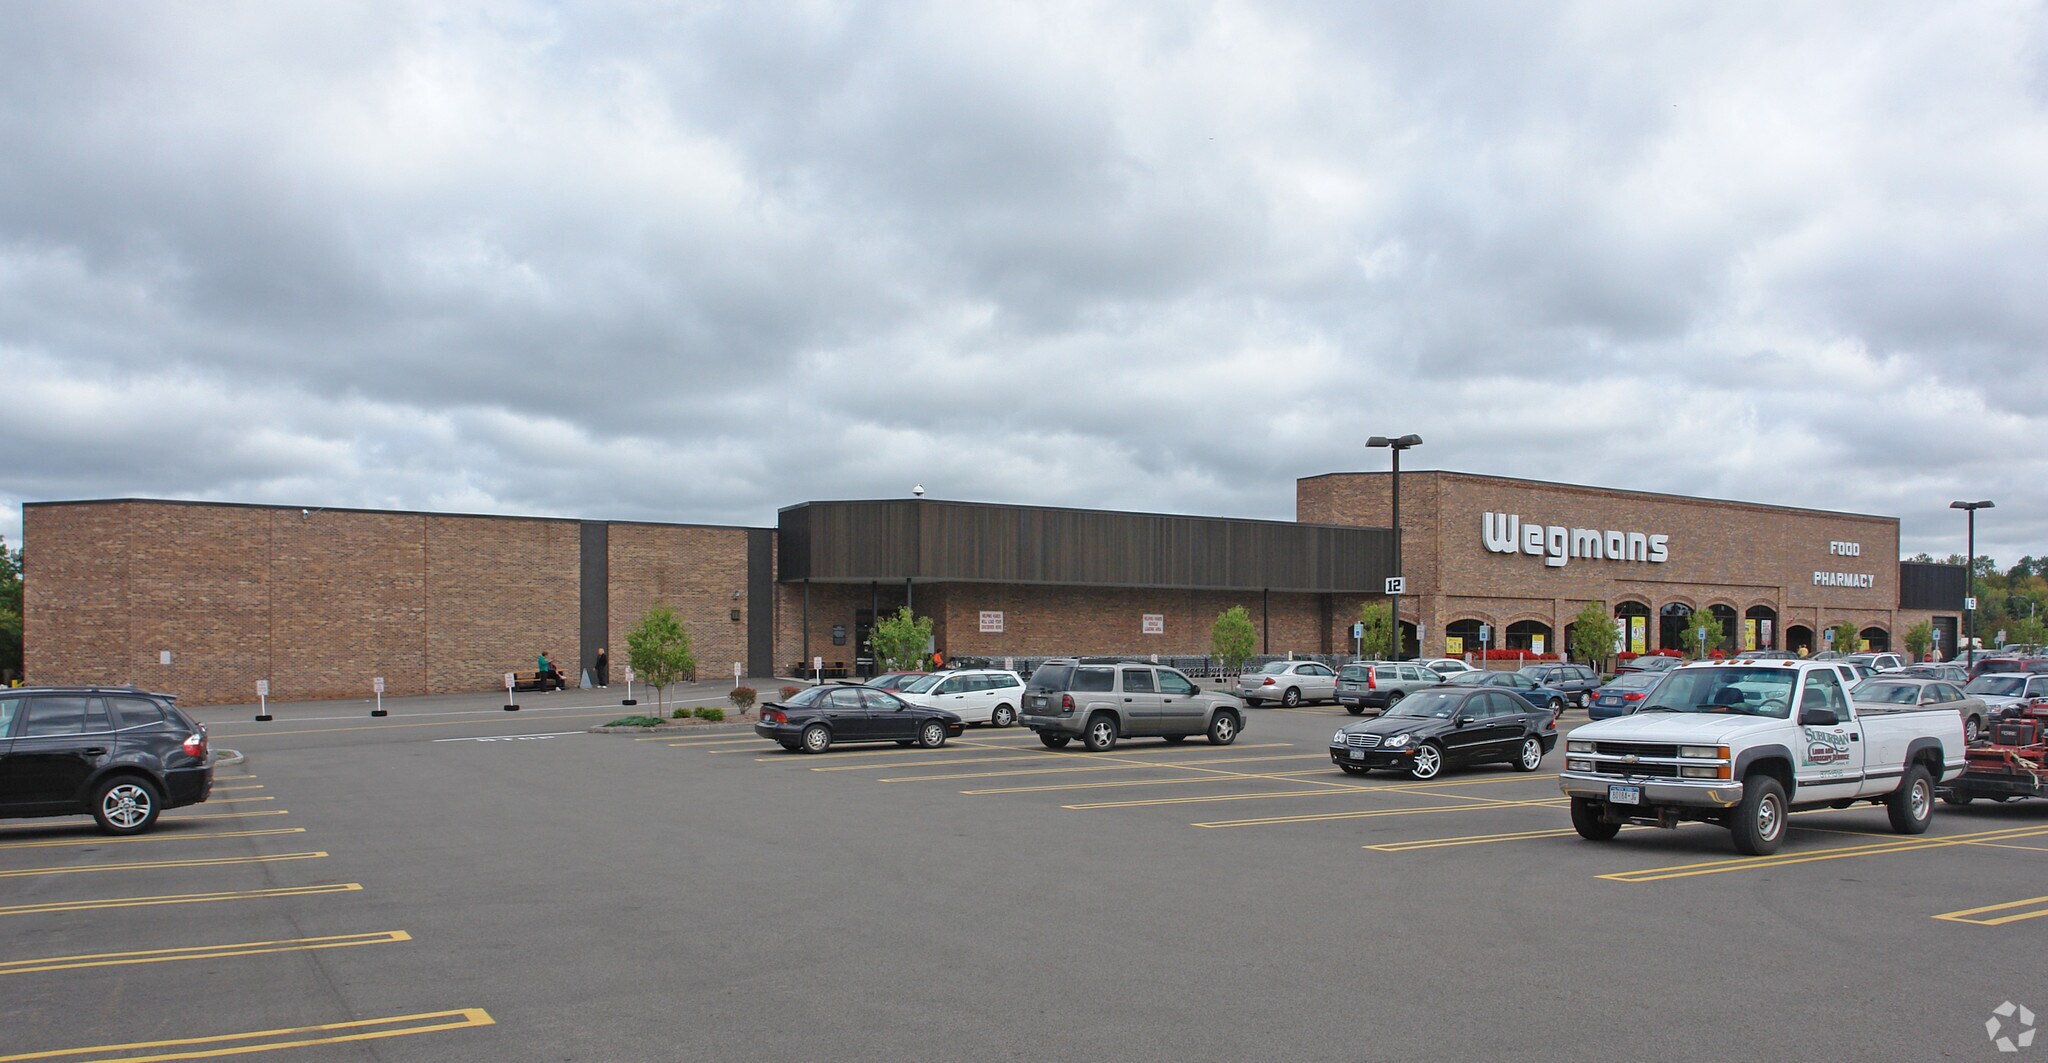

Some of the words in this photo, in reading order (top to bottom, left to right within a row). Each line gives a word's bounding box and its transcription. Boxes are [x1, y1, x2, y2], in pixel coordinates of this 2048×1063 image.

[1482, 512, 1669, 567] Wegmans
[1829, 541, 1860, 556] FOOD
[1387, 579, 1401, 592] 12
[1813, 571, 1875, 588] PHARMACY
[1970, 599, 1975, 608] 9
